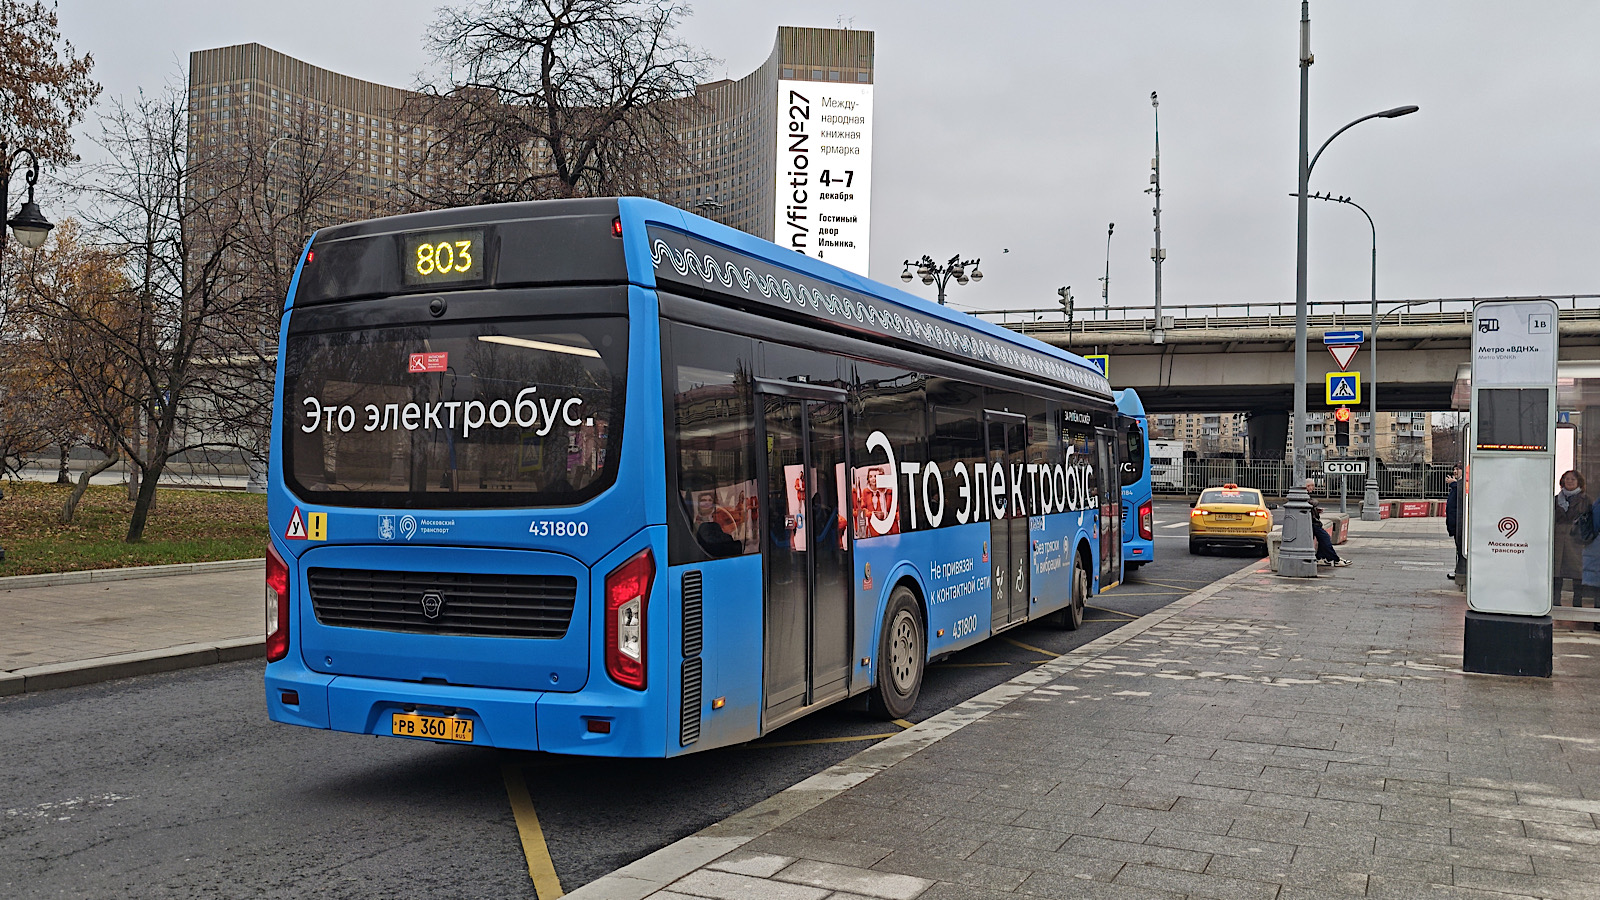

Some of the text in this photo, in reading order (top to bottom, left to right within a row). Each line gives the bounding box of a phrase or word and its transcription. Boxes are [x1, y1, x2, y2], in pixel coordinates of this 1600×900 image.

[821, 97, 859, 111] Между-
[821, 114, 865, 125] народная
[820, 130, 861, 140] книжная
[820, 145, 860, 156] ярмарка
[819, 191, 854, 202] декабря
[819, 213, 858, 224] Гостиный
[819, 227, 839, 236] двор
[818, 237, 856, 249] Ильинка,
[416, 239, 473, 276] 803
[818, 250, 824, 259] 4
[1506, 345, 1539, 353] «ВДНХ»
[301, 386, 594, 438] Это электробус.
[1328, 463, 1362, 472] СТОП
[865, 430, 944, 535] Это
[528, 521, 589, 537] 431800
[930, 557, 974, 581] Не привязан
[930, 575, 991, 606] к контактной сети
[952, 614, 977, 640] 431800
[420, 718, 446, 736] 360
[454, 720, 468, 734] 77
